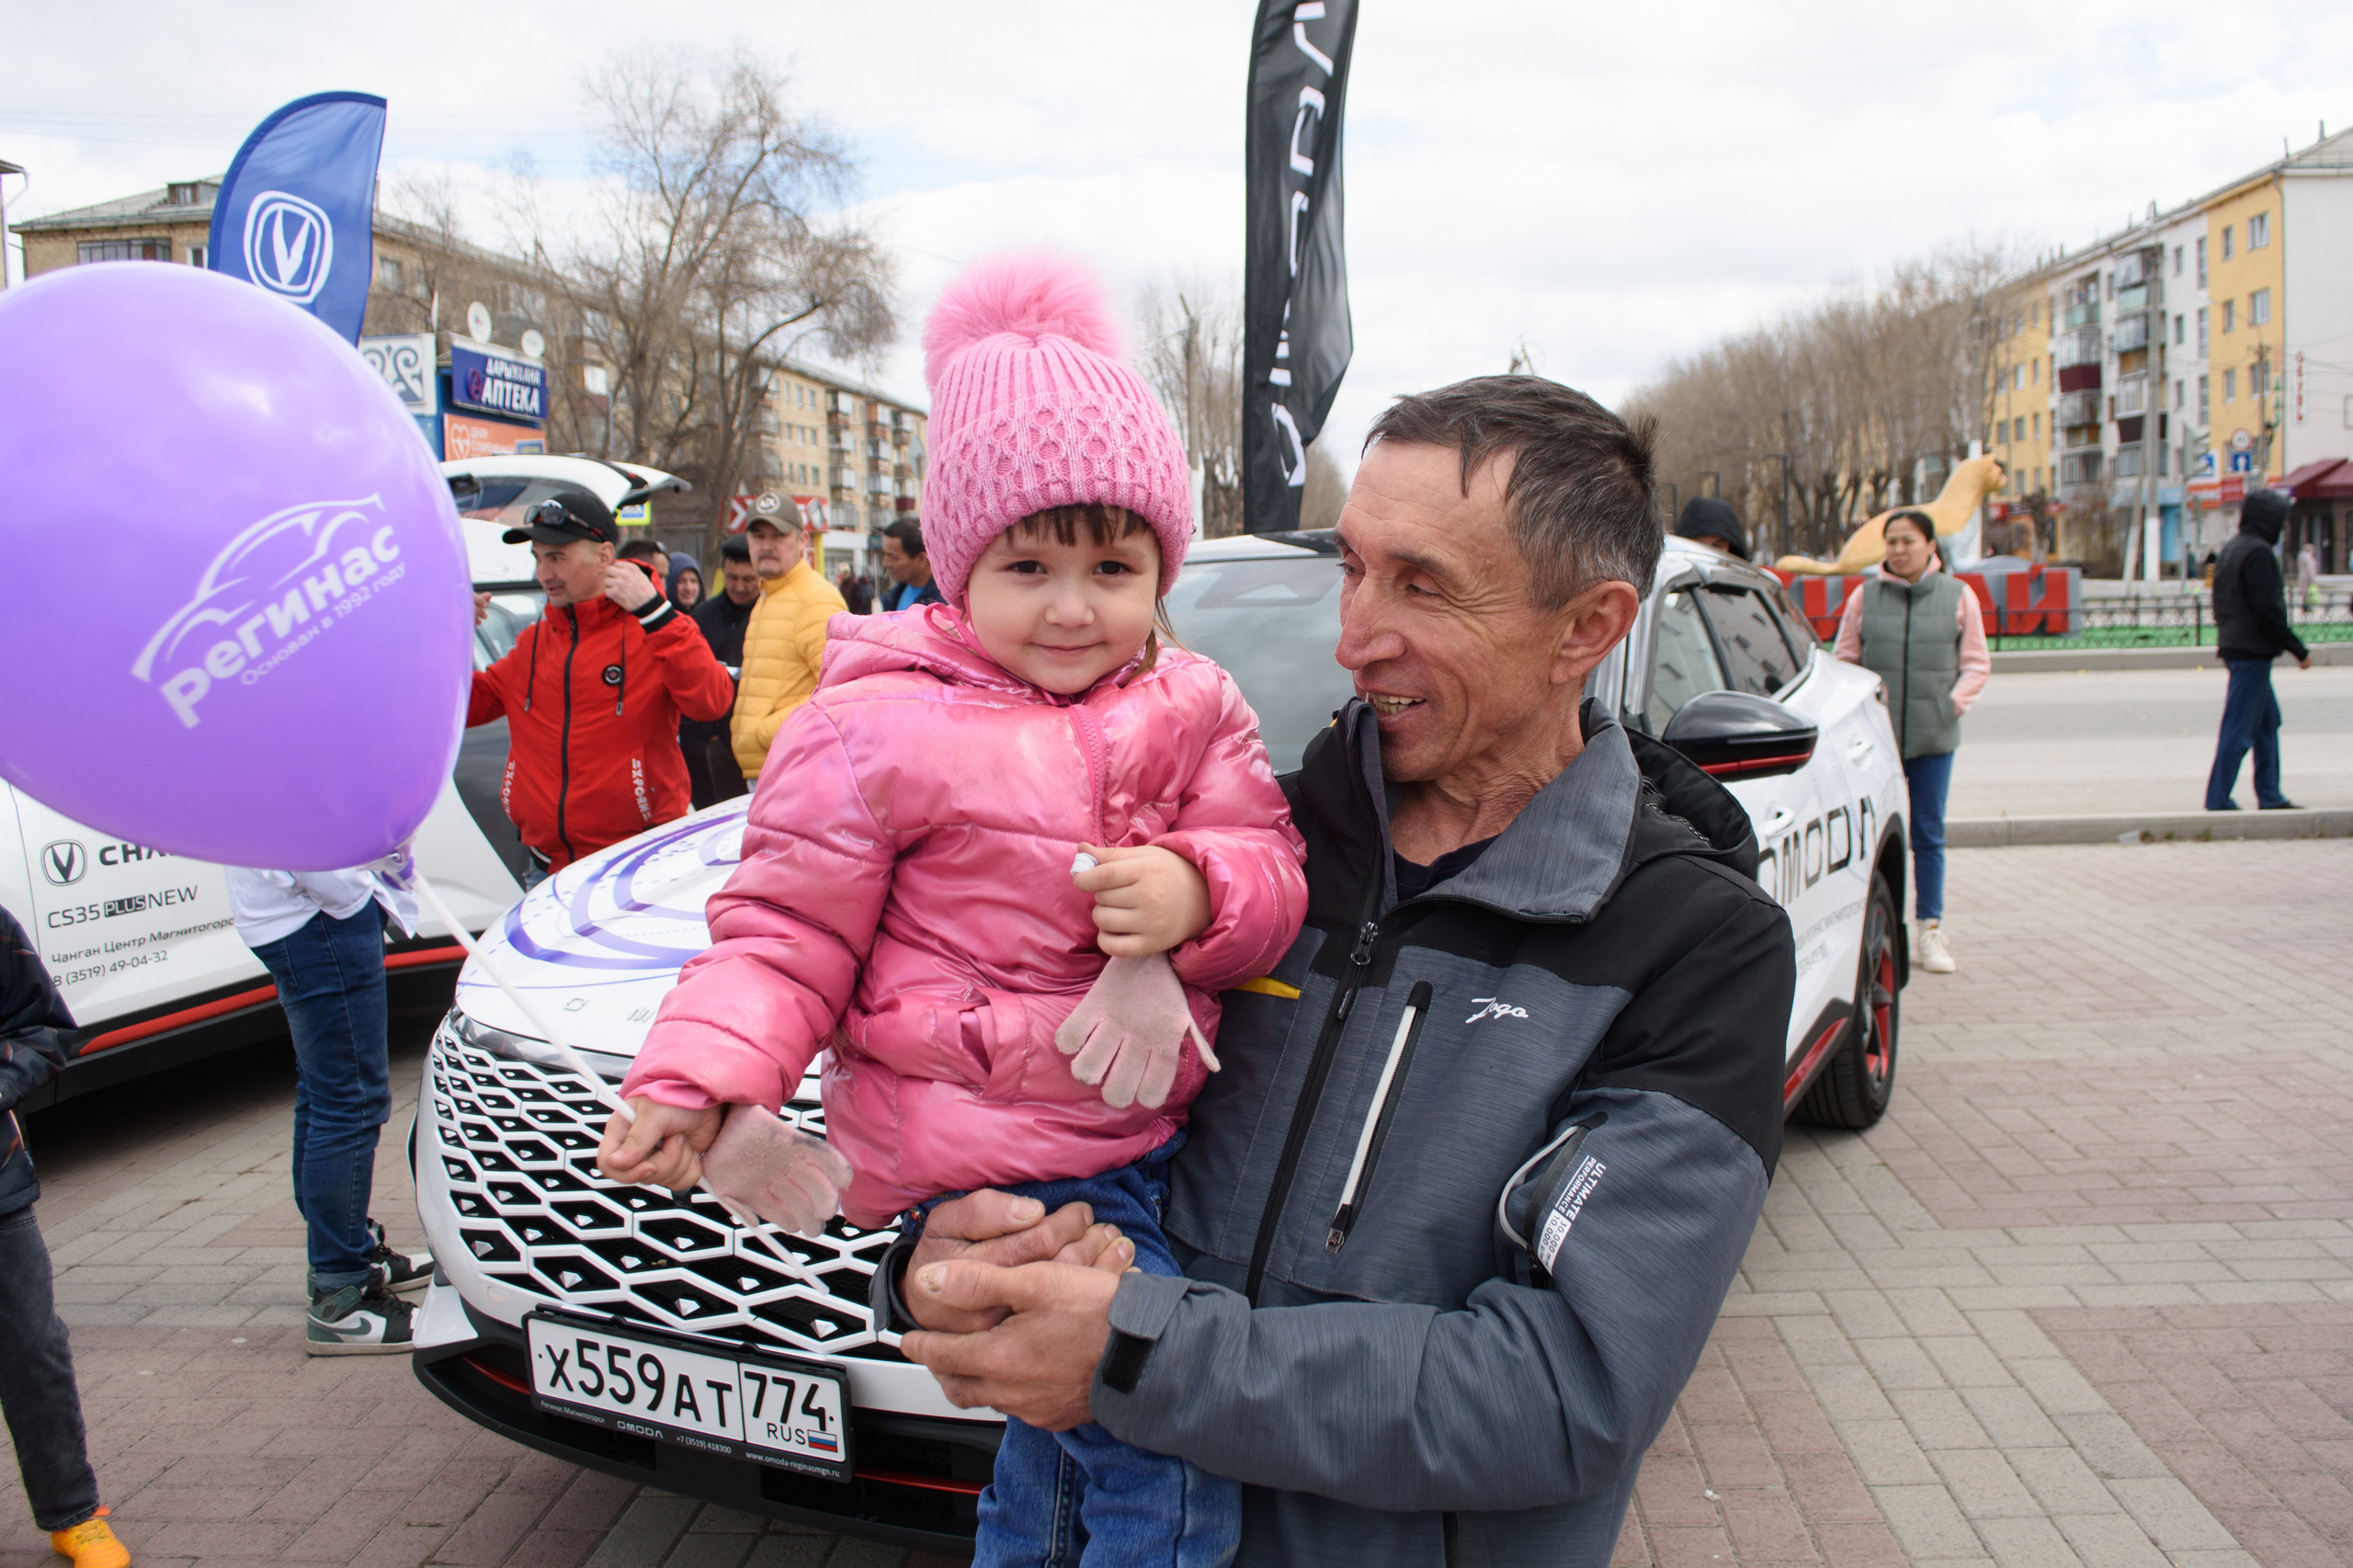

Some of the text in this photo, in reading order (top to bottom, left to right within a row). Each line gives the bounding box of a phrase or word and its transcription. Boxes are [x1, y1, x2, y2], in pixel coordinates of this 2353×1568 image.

[481, 377, 540, 415] АПТЕКА
[160, 525, 401, 729] Регинас
[242, 561, 405, 685] Основан в 1992 году
[48, 903, 100, 928] CS35
[148, 885, 198, 908] NEW
[51, 917, 234, 964] Чанган Центр Магнитогорс
[65, 964, 107, 985] (3519)
[109, 949, 168, 972] 49-04-32
[1558, 1157, 1597, 1213] PERFORMANCE
[1565, 1163, 1607, 1221] ULTIMATE
[1542, 1215, 1560, 1246] 10.000
[1549, 1220, 1567, 1253] 30.000
[744, 1370, 827, 1432] 774
[676, 1435, 732, 1454] +7 (3519) 418300
[767, 1422, 806, 1446] RUS
